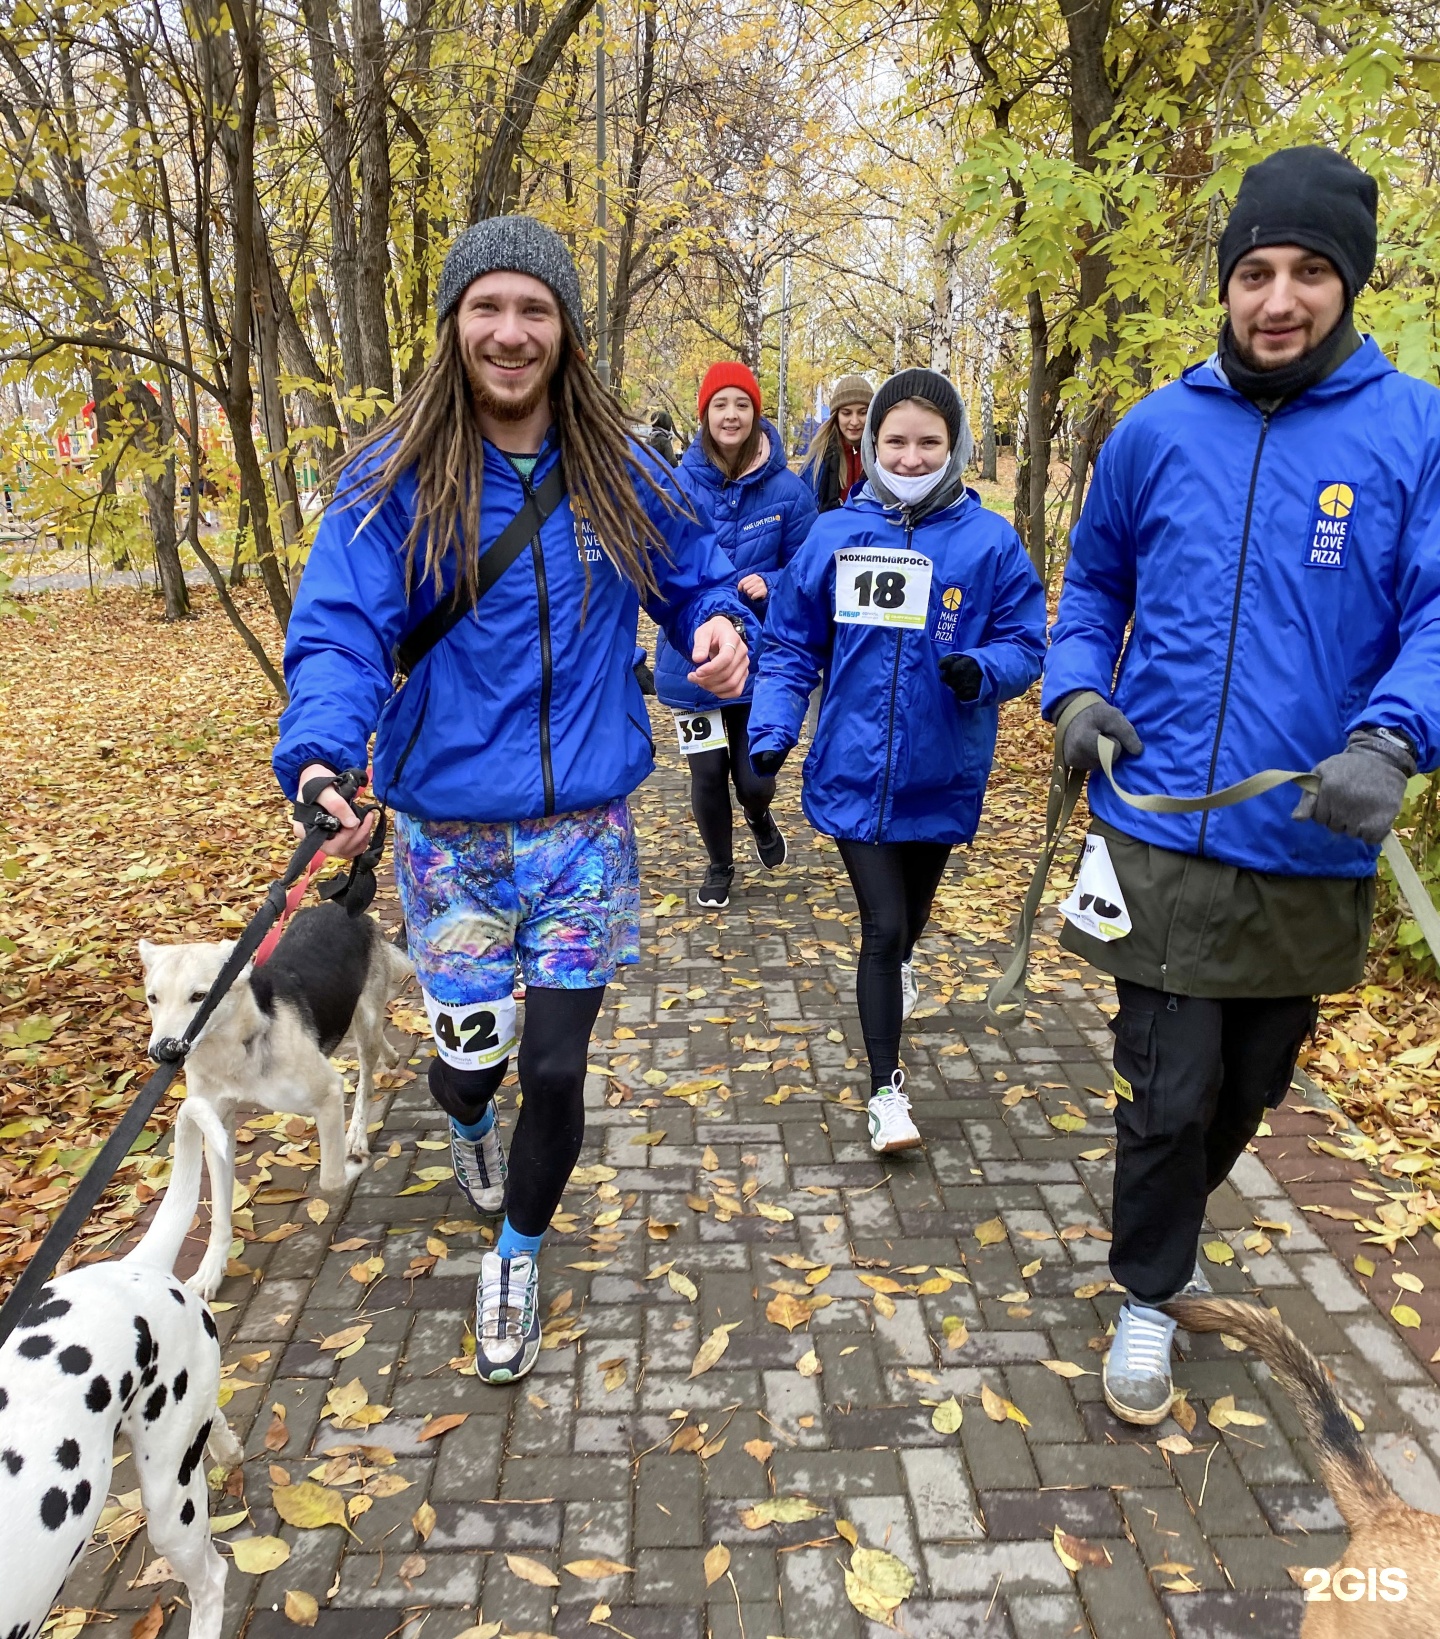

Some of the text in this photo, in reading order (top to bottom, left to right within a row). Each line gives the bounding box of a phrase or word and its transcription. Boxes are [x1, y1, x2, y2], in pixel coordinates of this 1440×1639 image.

[754, 518, 765, 528] LOVE
[1316, 519, 1348, 535] MAKE
[1313, 534, 1345, 550] LOVE
[577, 549, 603, 562] PZZA
[1310, 549, 1341, 565] PIZZA
[853, 570, 907, 609] 18
[838, 610, 861, 618] СИБУР
[940, 611, 959, 623] MAKE
[937, 621, 956, 632] LOVE
[934, 630, 953, 642] PIZZA
[679, 716, 712, 743] 39
[435, 1010, 500, 1054] 42
